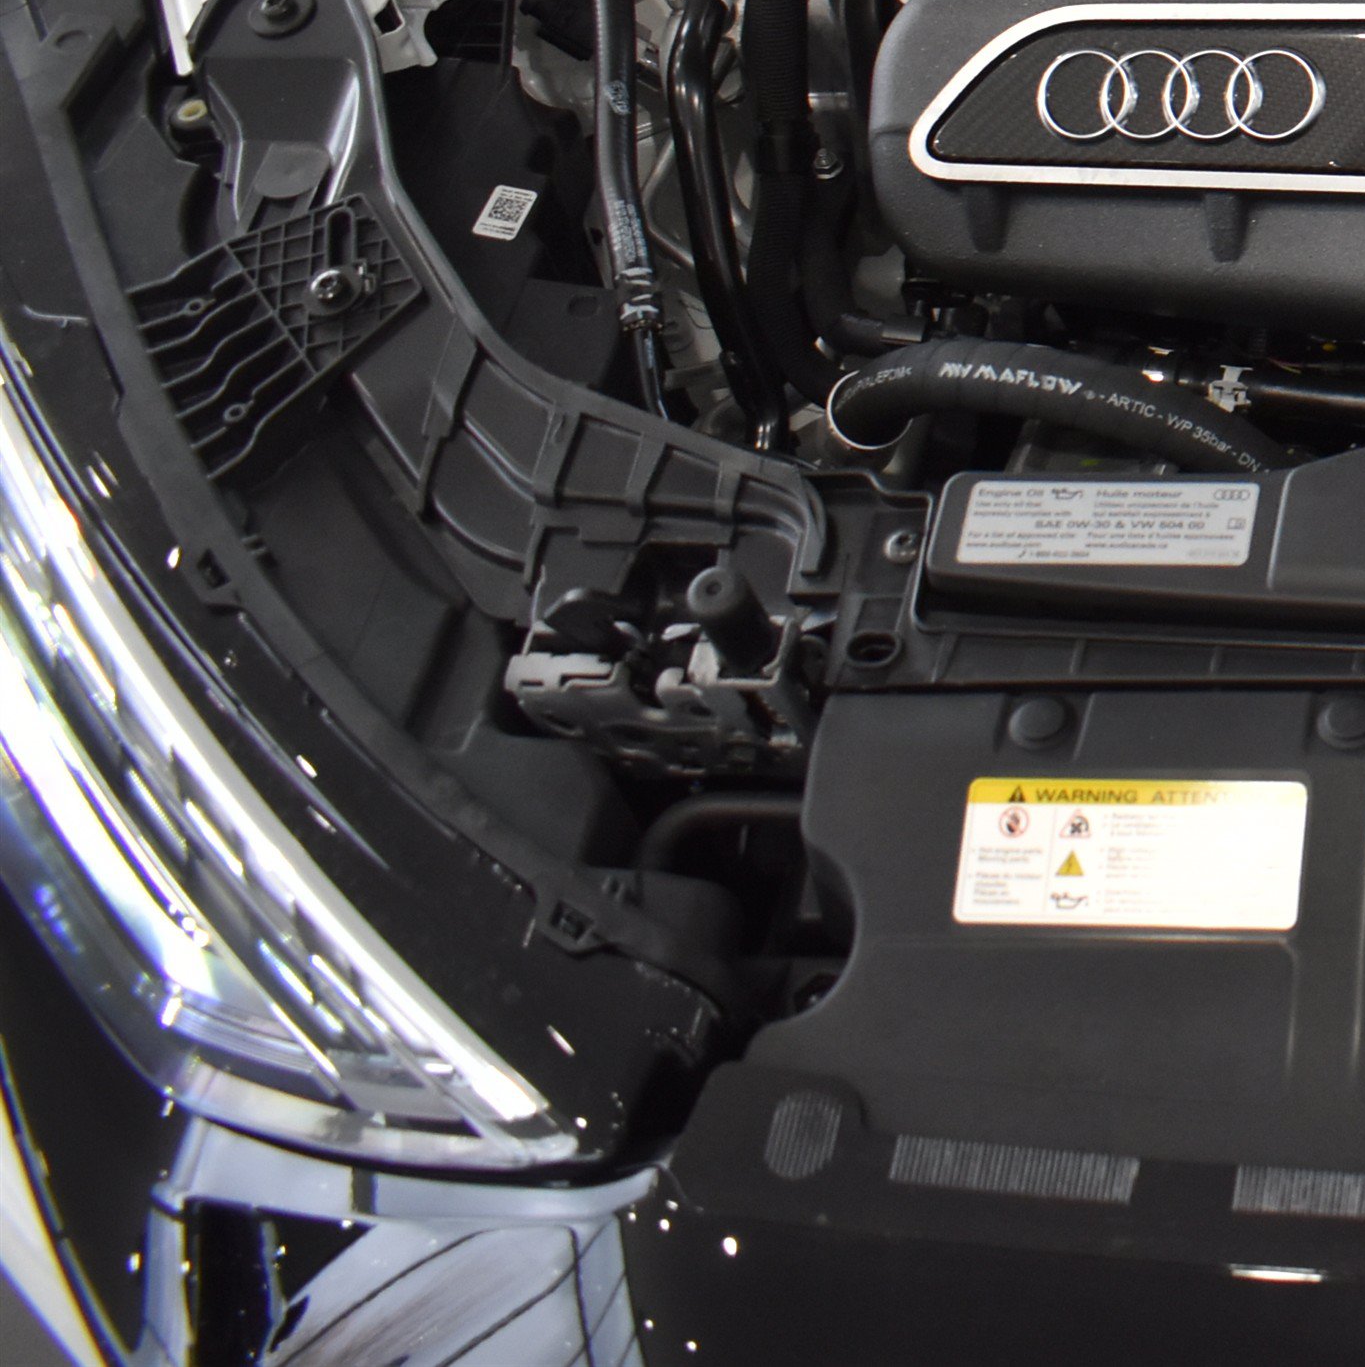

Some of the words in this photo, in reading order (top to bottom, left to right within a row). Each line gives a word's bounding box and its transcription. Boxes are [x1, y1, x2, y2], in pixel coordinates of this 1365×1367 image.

[972, 364, 1083, 396] MAFLOW
[1107, 392, 1156, 419] ARTIC
[1035, 788, 1138, 804] WARNING
